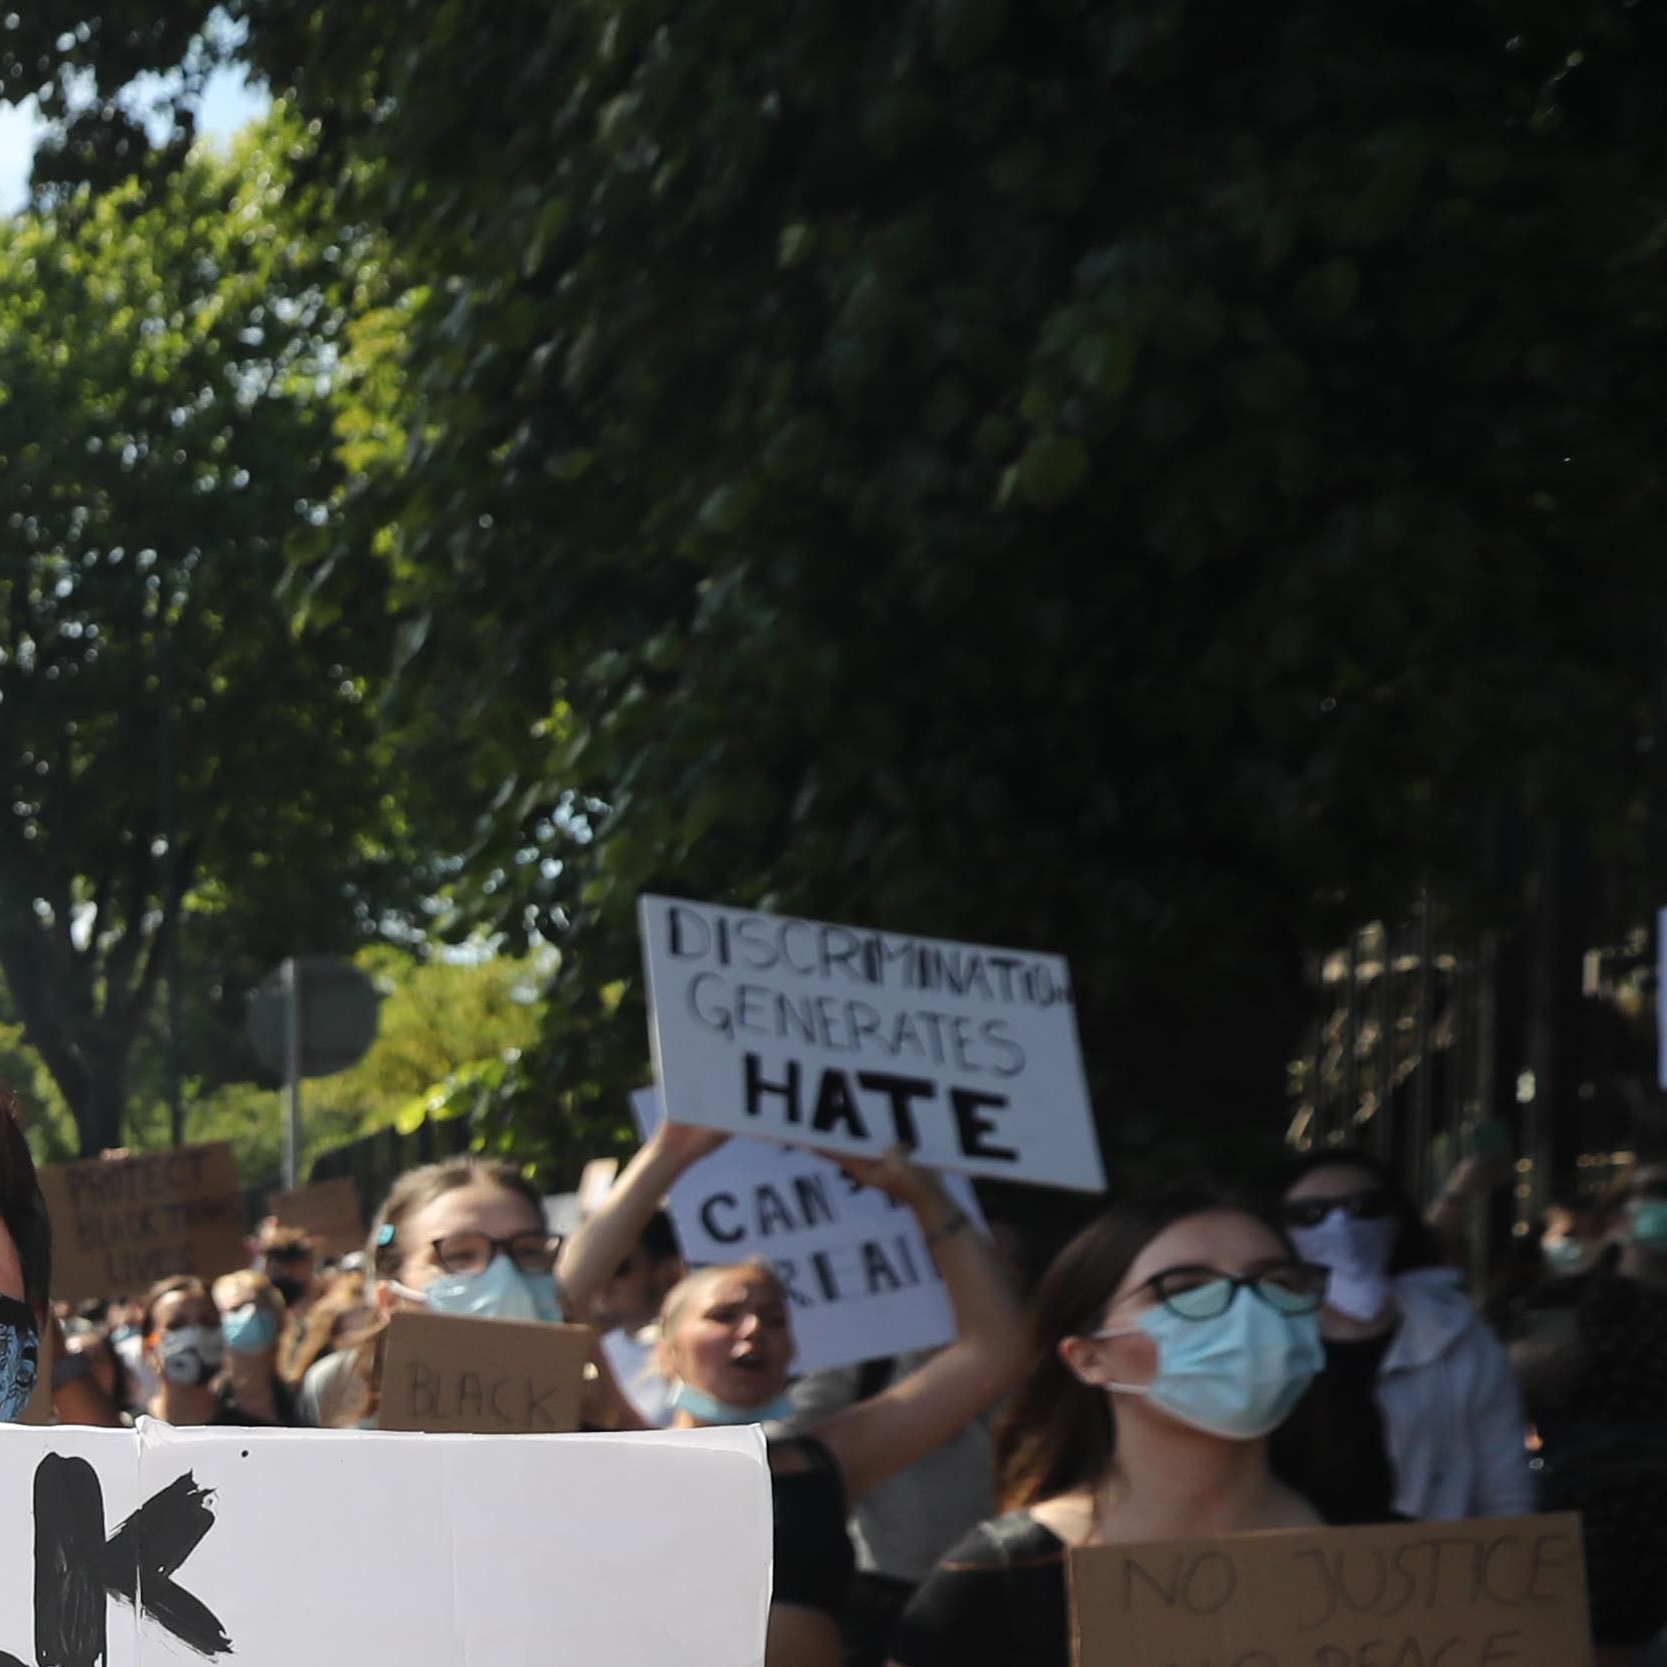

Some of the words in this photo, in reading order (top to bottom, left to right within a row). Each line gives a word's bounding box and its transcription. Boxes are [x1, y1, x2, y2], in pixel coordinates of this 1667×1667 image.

[687, 970, 1029, 1079] GENERATES
[743, 1051, 1020, 1164] HATE
[405, 1359, 559, 1430] BLACK
[1122, 1548, 1241, 1616] NO
[1290, 1530, 1571, 1634] JUSTICE
